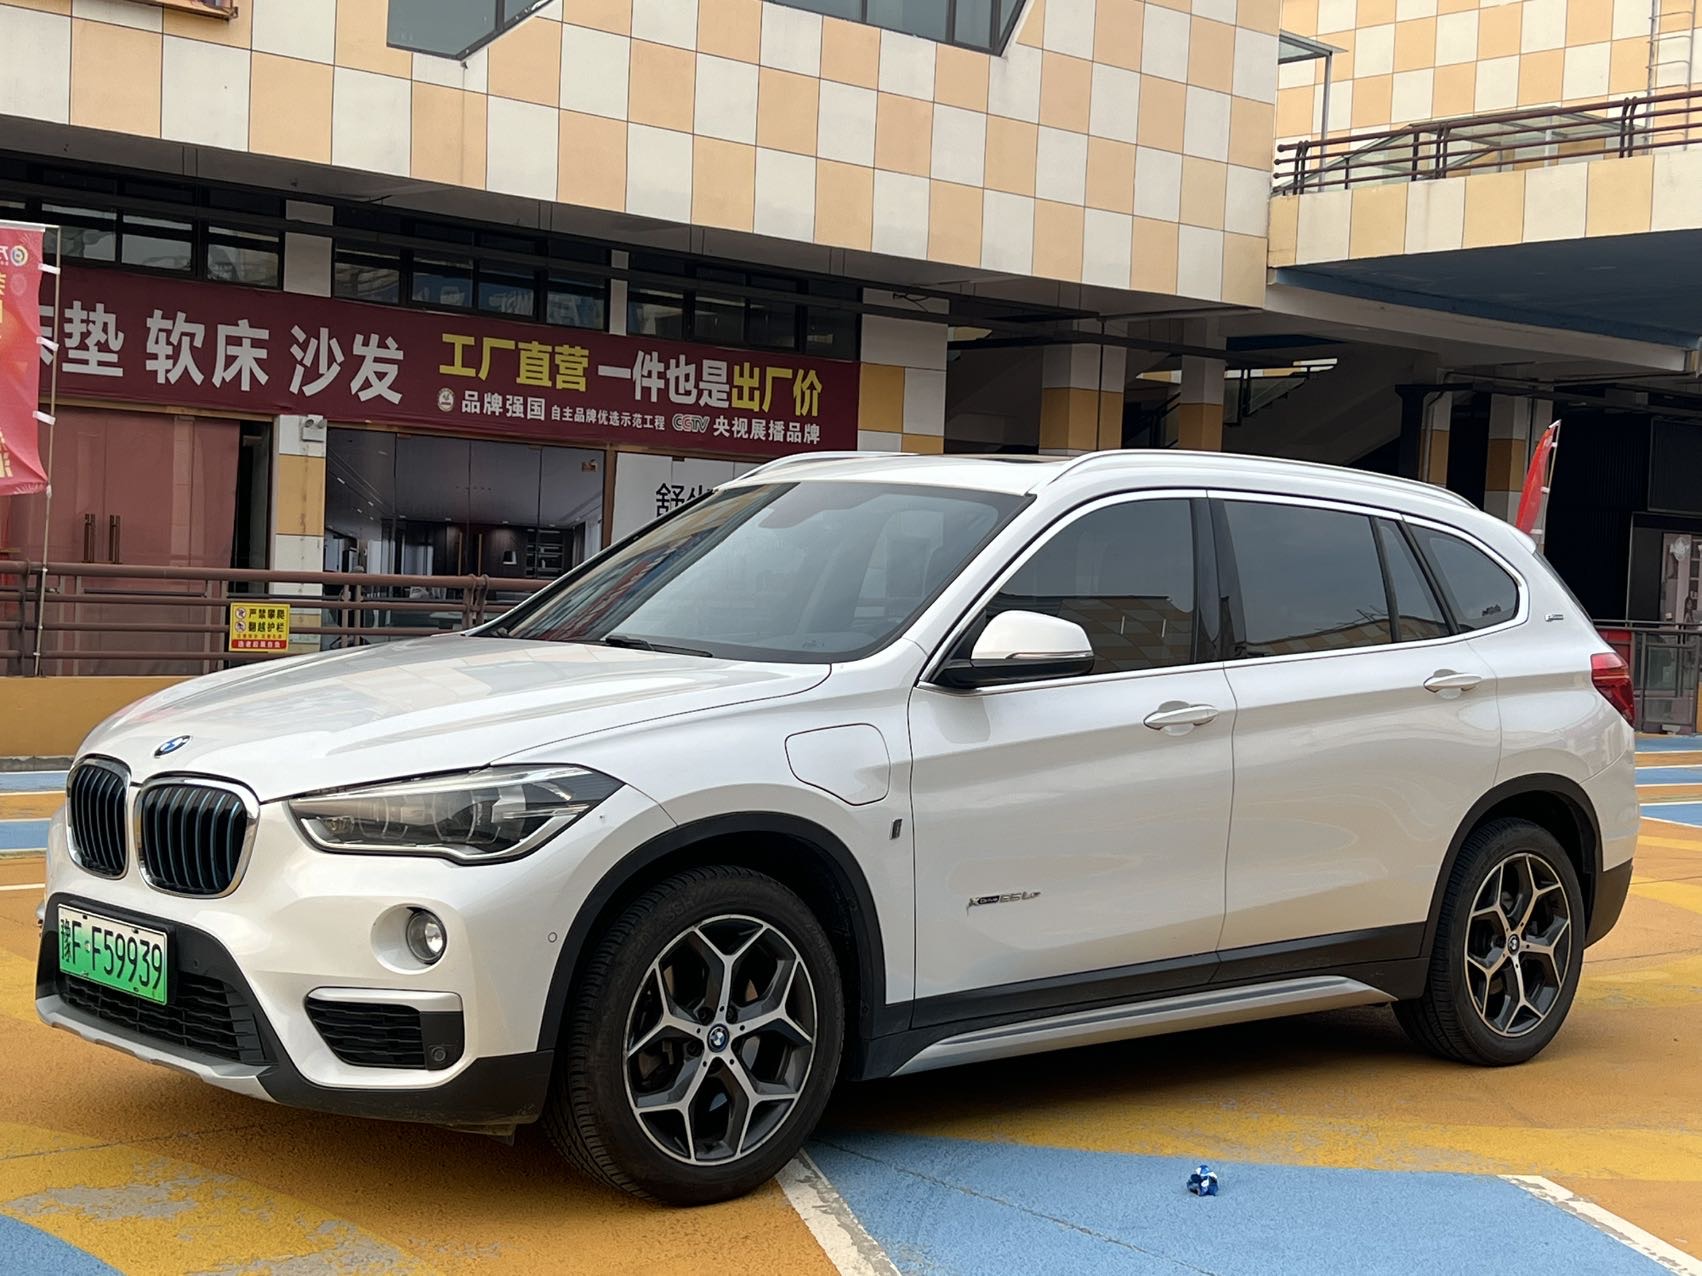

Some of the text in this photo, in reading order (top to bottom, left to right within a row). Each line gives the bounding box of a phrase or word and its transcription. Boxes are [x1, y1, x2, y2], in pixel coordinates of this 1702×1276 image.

[146, 308, 270, 392] 软床
[289, 324, 404, 405] 沙发
[439, 333, 823, 417] 工厂直营 一件也是出厂价
[461, 390, 545, 421] 品牌强国
[551, 404, 666, 431] 自主品牌优选示范工程
[672, 413, 710, 433] CCTV
[713, 415, 821, 445] 央视展播品牌
